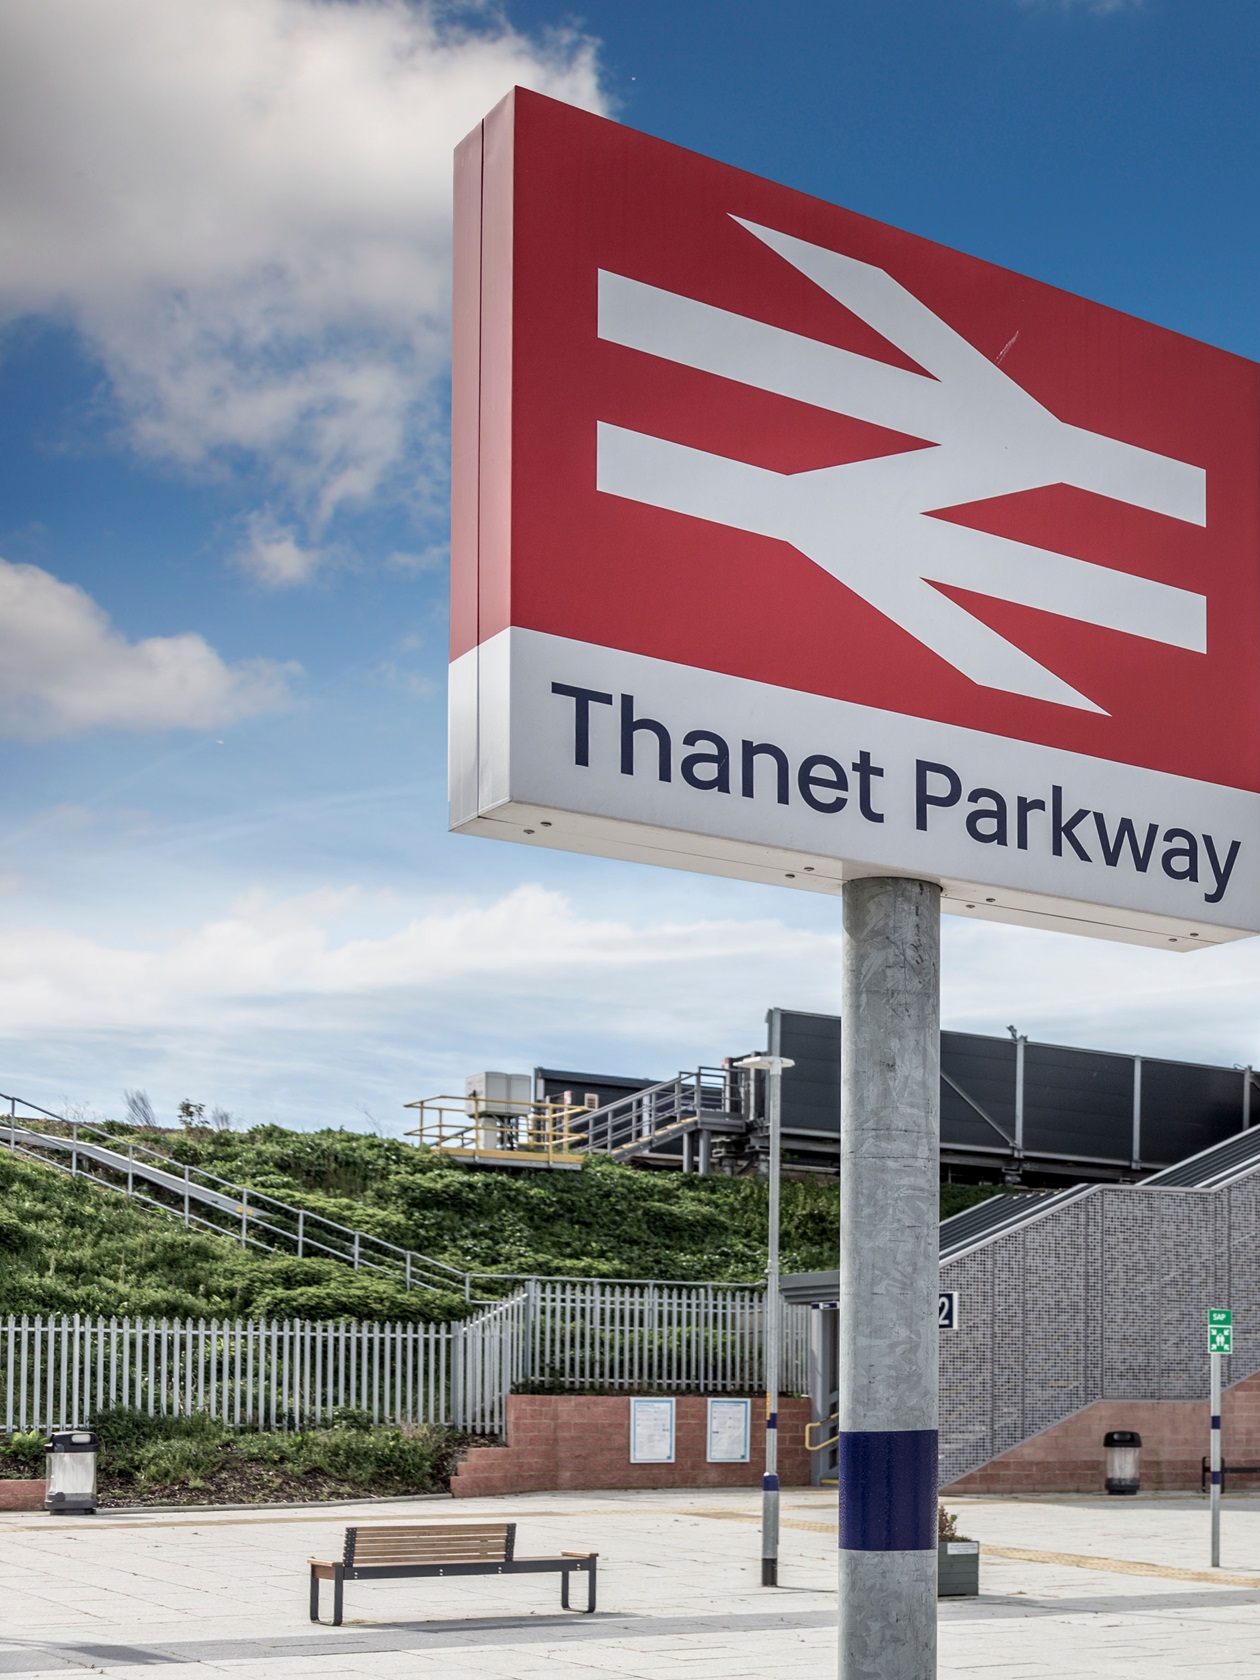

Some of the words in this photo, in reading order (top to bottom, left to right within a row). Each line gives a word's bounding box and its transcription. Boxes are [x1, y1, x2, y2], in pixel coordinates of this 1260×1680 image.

[551, 681, 885, 824] Thanet
[915, 758, 1242, 904] Parkway
[939, 1296, 950, 1325] 2
[1212, 1313, 1227, 1321] SAP
